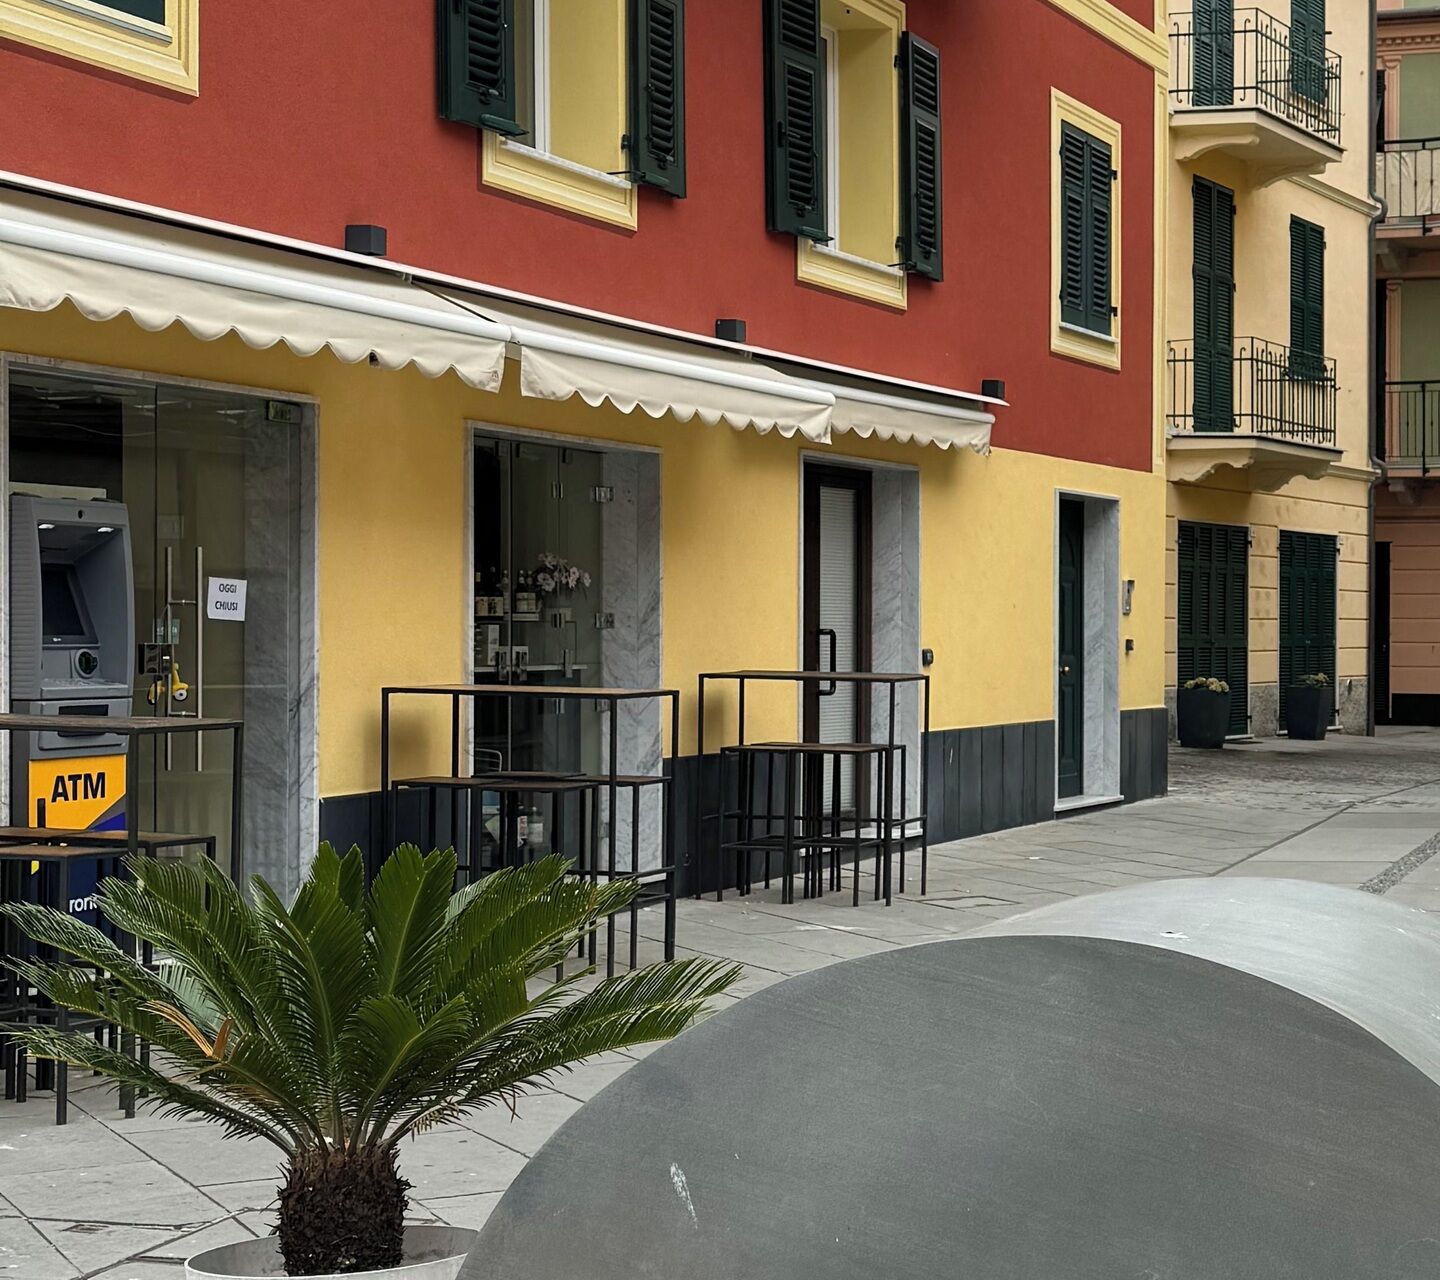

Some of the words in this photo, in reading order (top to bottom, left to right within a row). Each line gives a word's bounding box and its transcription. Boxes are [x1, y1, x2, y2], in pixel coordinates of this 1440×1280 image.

[219, 583, 237, 594] OGGI
[215, 600, 238, 611] CHIUSI
[51, 772, 105, 803] ATM
